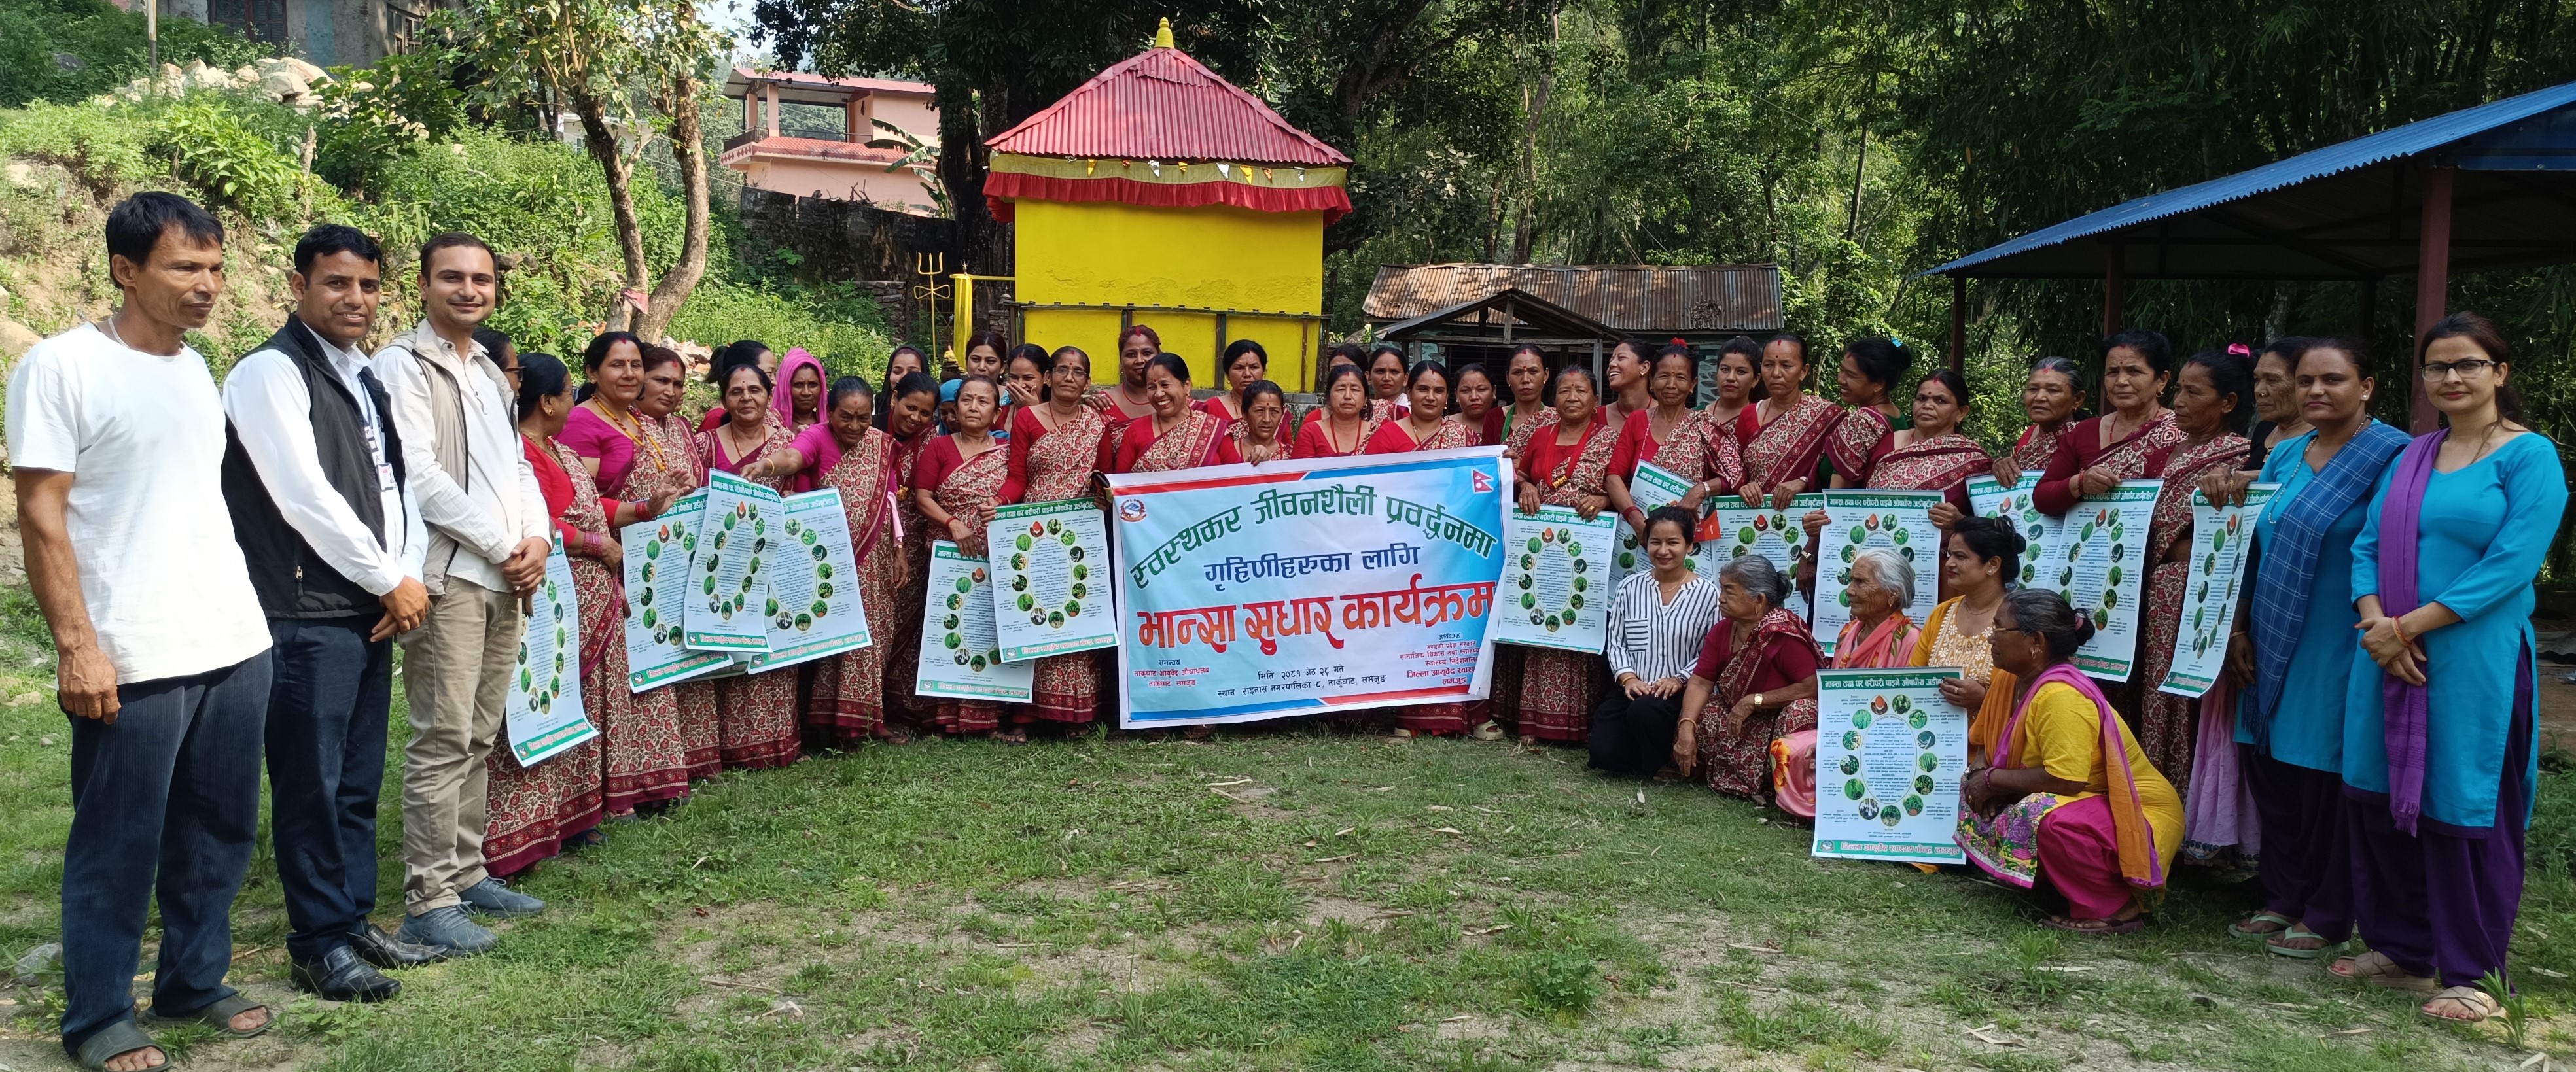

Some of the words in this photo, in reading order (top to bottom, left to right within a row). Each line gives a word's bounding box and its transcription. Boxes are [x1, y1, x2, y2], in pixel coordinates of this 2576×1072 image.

[1130, 506, 1242, 589] स्वस्थकर
[1250, 484, 1377, 524] जीवनशैली
[1204, 552, 1352, 591] गृहिणीहरुका
[1361, 542, 1420, 570] लागि
[1137, 605, 1237, 653] भान्सा
[1243, 597, 1344, 655] सुधार
[1340, 573, 1496, 630] कार्यक्रम
[1400, 651, 1424, 660] सामाजिक
[1258, 670, 1274, 680] मिति
[1281, 670, 1301, 680] २०८१
[1305, 667, 1316, 676] जेठ
[1333, 664, 1344, 672] गते
[1218, 689, 1235, 698] स्थान
[1241, 685, 1267, 696] राइनास
